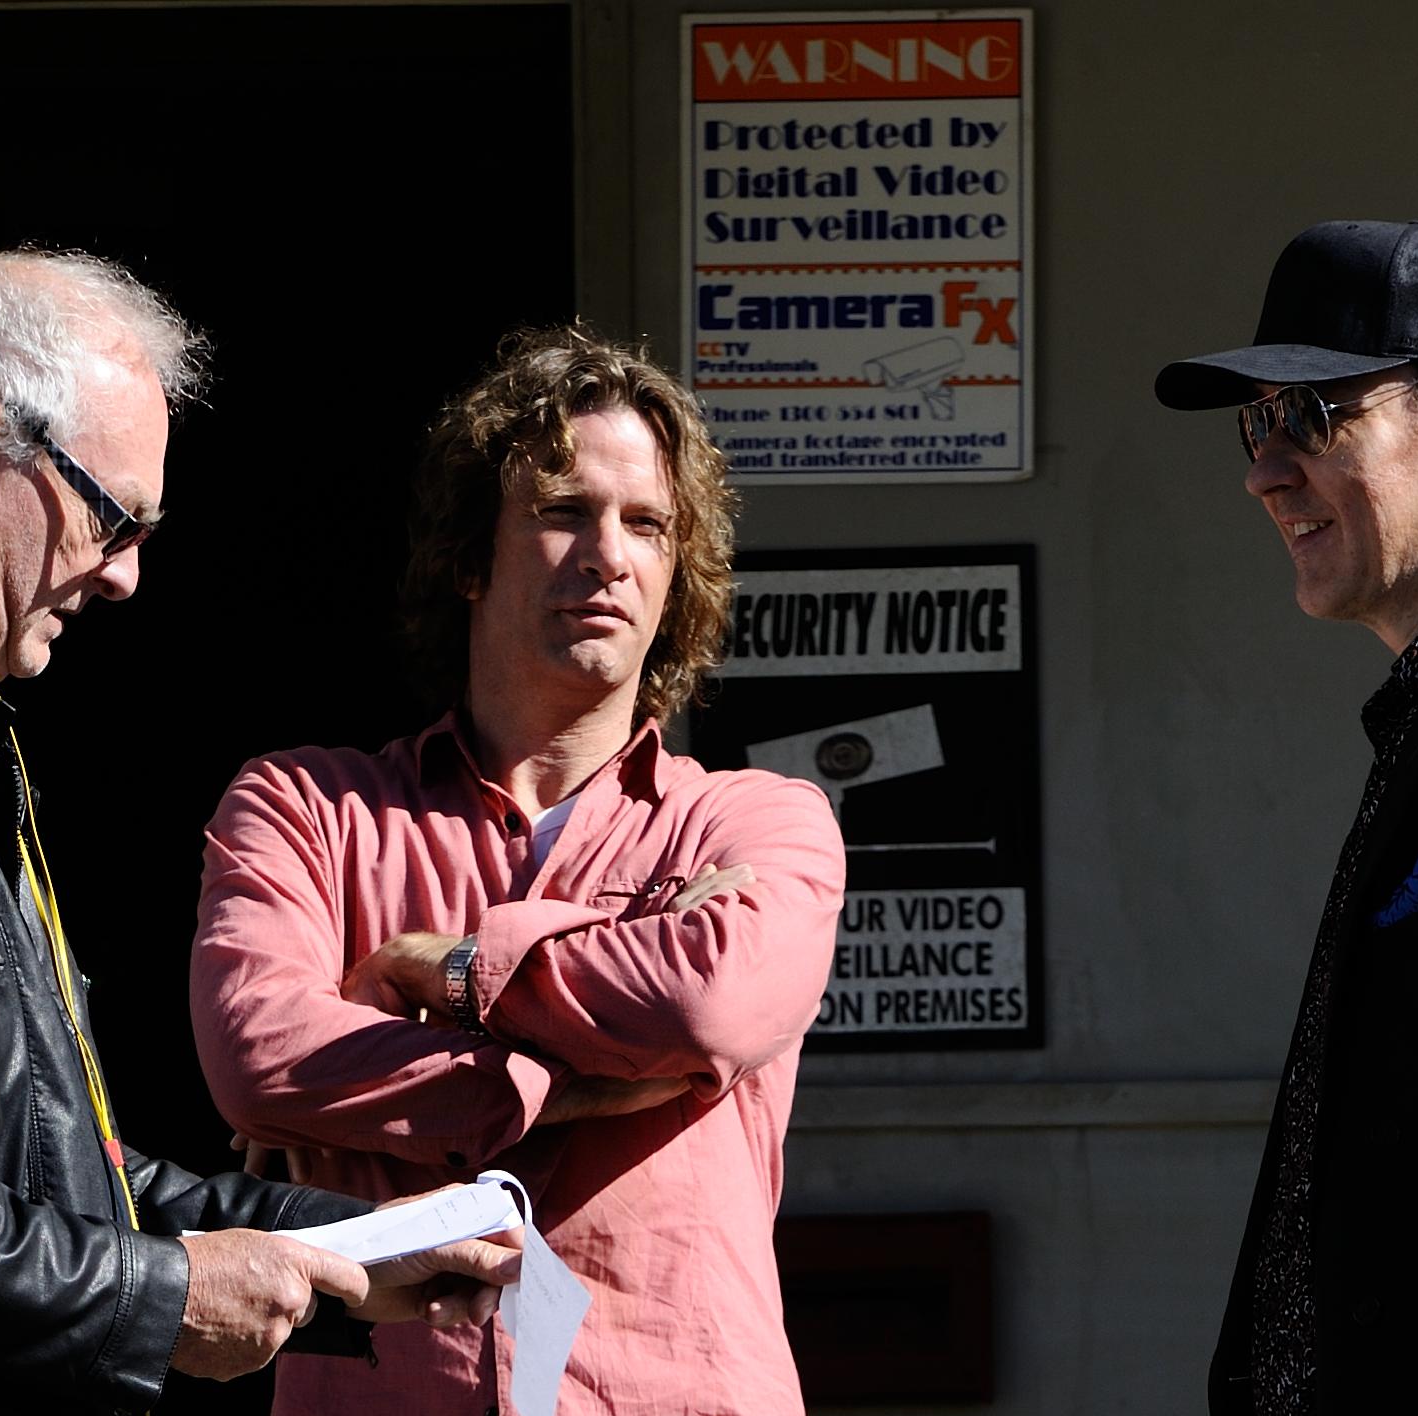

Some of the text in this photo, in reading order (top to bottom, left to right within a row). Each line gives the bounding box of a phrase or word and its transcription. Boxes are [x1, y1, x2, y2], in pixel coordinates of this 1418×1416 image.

[701, 35, 1014, 86] WARNING
[703, 117, 1008, 150] Protected by
[703, 164, 1009, 199] Digital Video
[704, 209, 1008, 243] Surveillance
[697, 342, 750, 357] CCTV
[698, 360, 819, 373] Professionals
[699, 406, 771, 421] hone
[781, 451, 907, 467] transferred
[913, 450, 983, 466] offsite
[803, 434, 885, 452] footage
[890, 432, 1007, 450] encrypted
[734, 588, 1008, 658] ECURITY NOTICE
[842, 895, 1003, 932] UR VIDEO
[834, 942, 994, 979] EILLANCE
[815, 987, 1023, 1025] ON PREMISES
